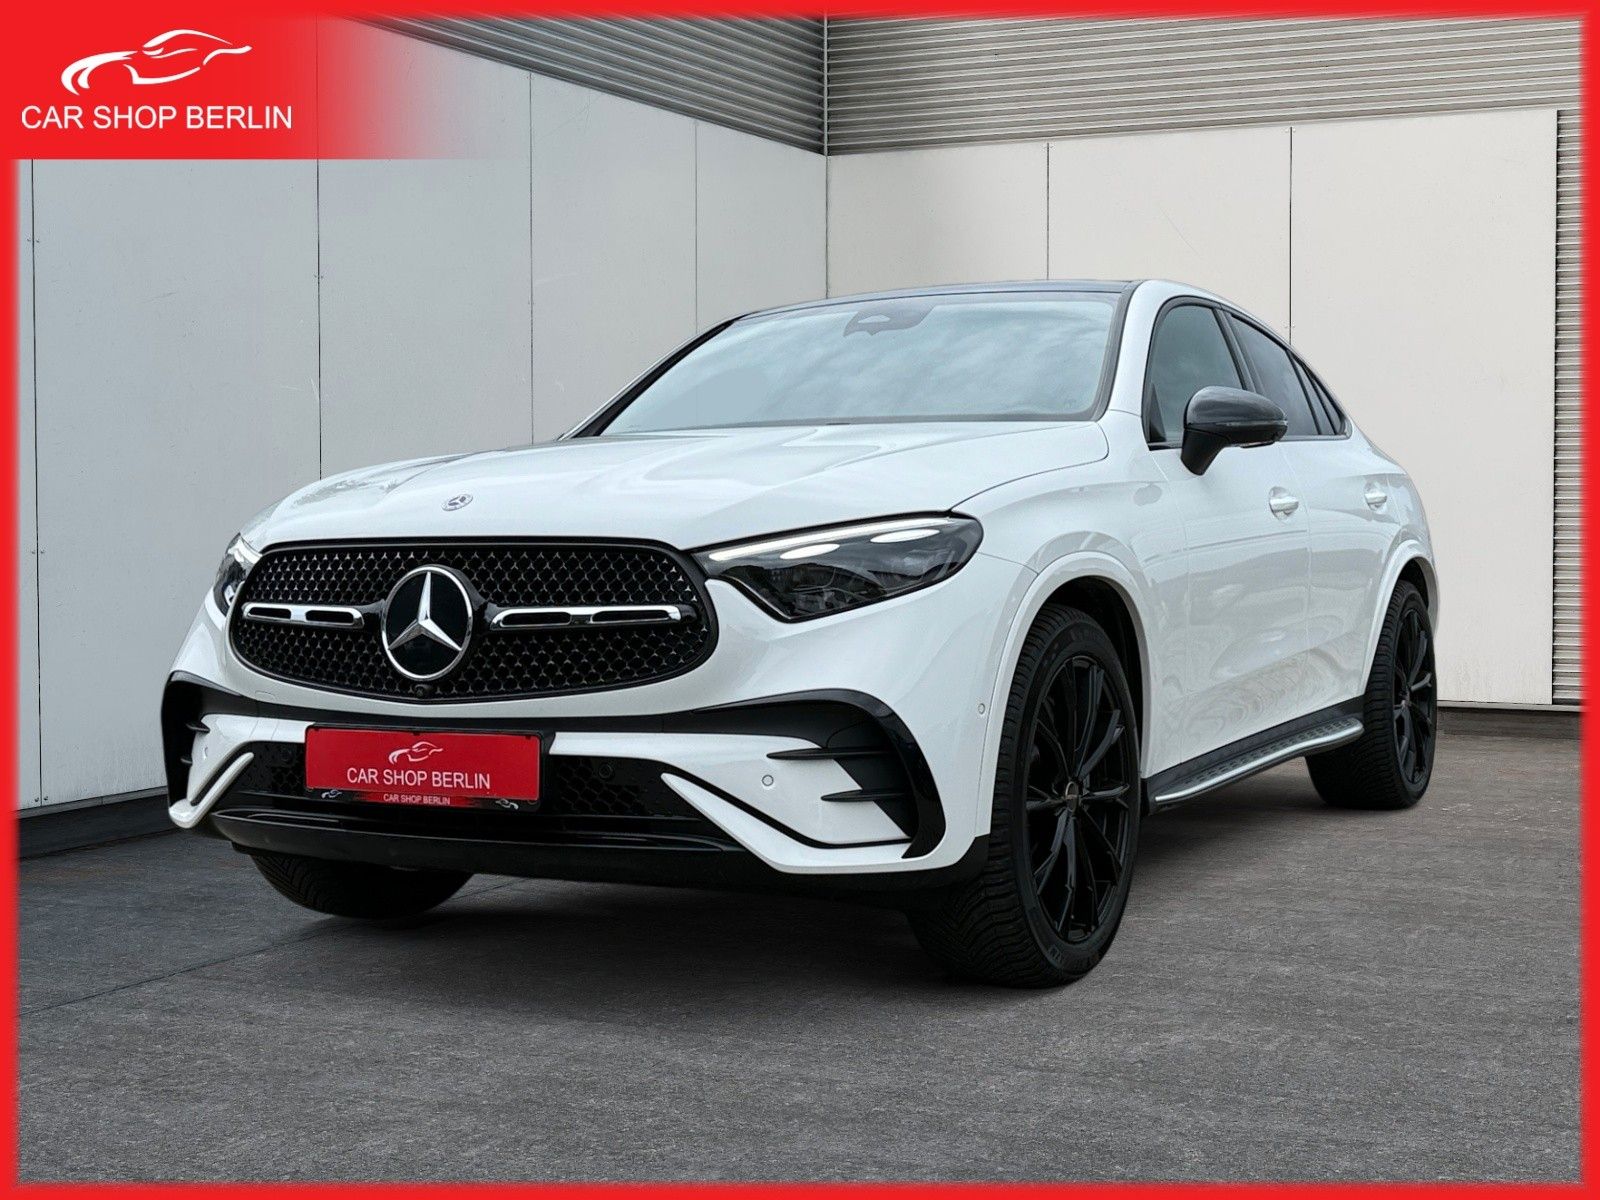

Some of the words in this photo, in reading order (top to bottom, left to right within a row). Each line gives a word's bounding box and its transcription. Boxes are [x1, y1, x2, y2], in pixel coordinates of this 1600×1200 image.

[347, 768, 379, 785] CAR
[383, 769, 427, 787] SHOP
[432, 771, 491, 789] BERLIN
[383, 793, 400, 803] CAR
[401, 794, 422, 804] SHOP
[423, 796, 450, 805] BERLIN
